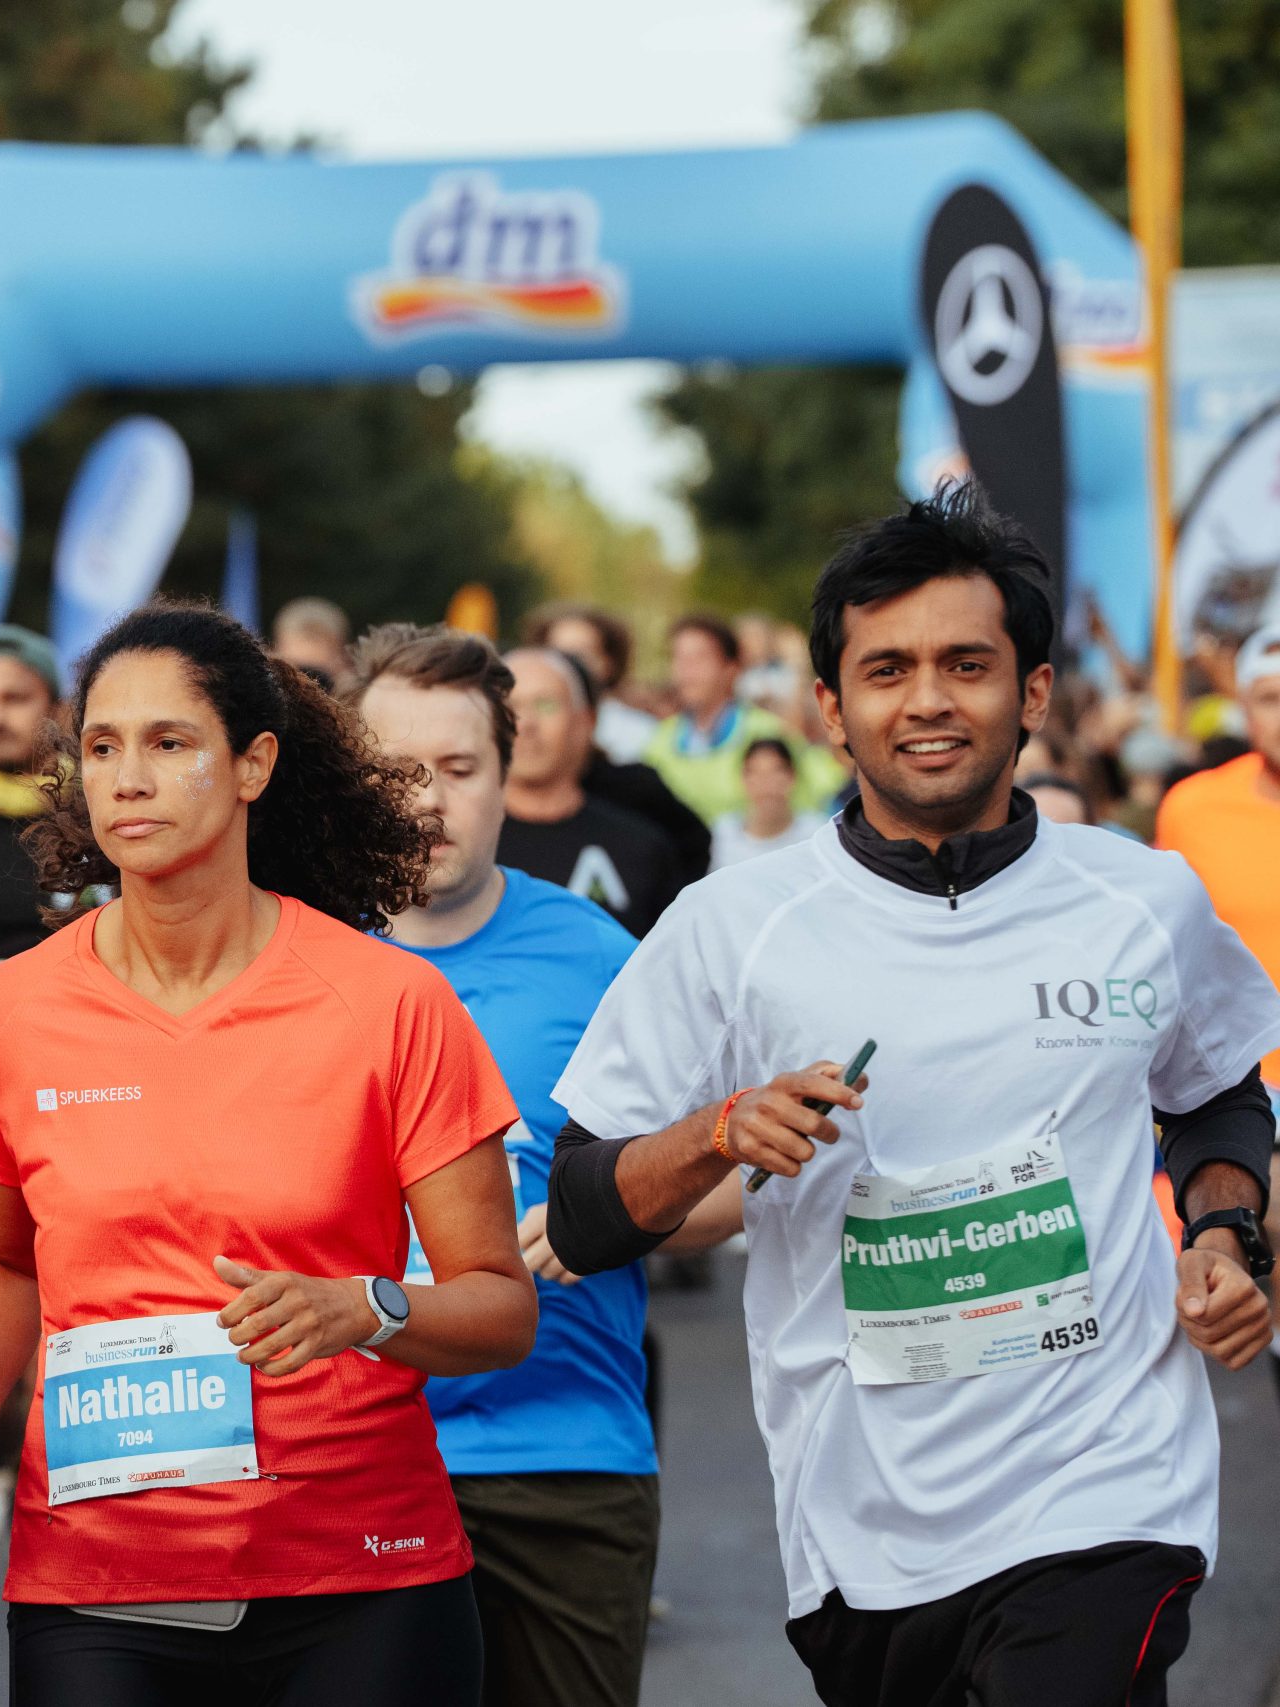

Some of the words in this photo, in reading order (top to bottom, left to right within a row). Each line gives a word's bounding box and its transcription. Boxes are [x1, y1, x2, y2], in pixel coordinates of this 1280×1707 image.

[1035, 1037, 1075, 1049] Know
[1076, 1034, 1104, 1047] how
[60, 1086, 142, 1105] SPUERKEESS
[1011, 1162, 1034, 1175] RUN
[1014, 1172, 1036, 1185] FOR
[979, 1183, 994, 1195] 26
[843, 1204, 1077, 1266] Pruthvi-Gerben
[944, 1272, 986, 1293] 4539
[1040, 1317, 1099, 1352] 4539
[158, 1344, 173, 1355] 26
[59, 1368, 226, 1429] Nathalie
[118, 1429, 153, 1447] 7094
[136, 1469, 184, 1481] BAUHAUS
[381, 1536, 425, 1551] G-SKIN
